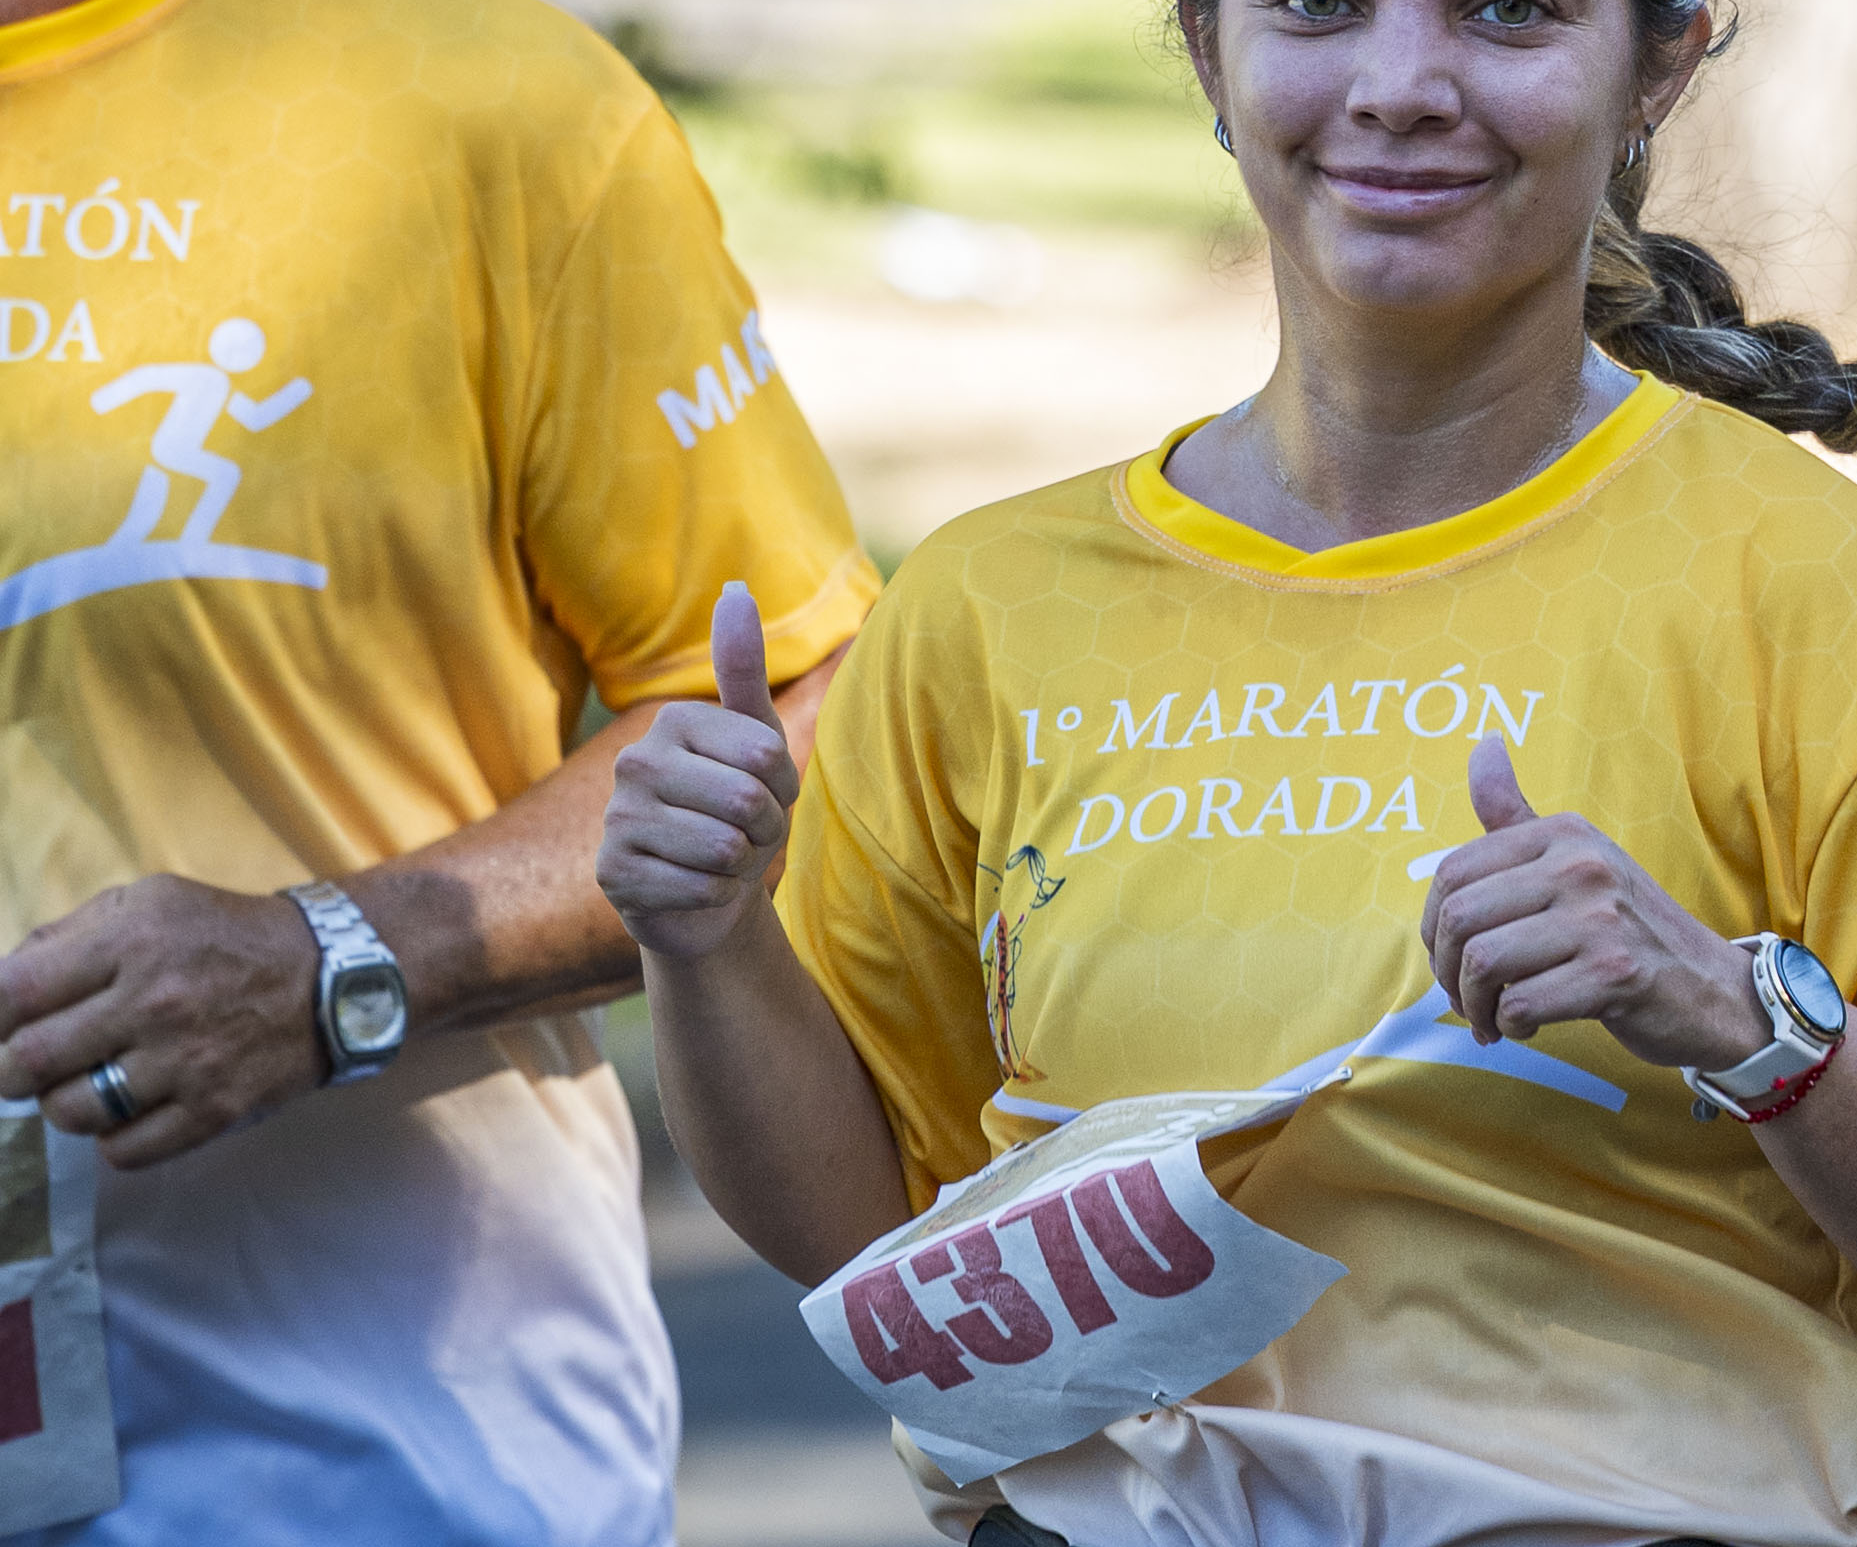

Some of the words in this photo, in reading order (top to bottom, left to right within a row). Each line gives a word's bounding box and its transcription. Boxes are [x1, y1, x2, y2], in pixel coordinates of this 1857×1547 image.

[0, 176, 202, 262] TÓN
[1097, 663, 1545, 754] MARATÓN
[1064, 775, 1425, 857] DORADA
[841, 1158, 1215, 1392] 4370
